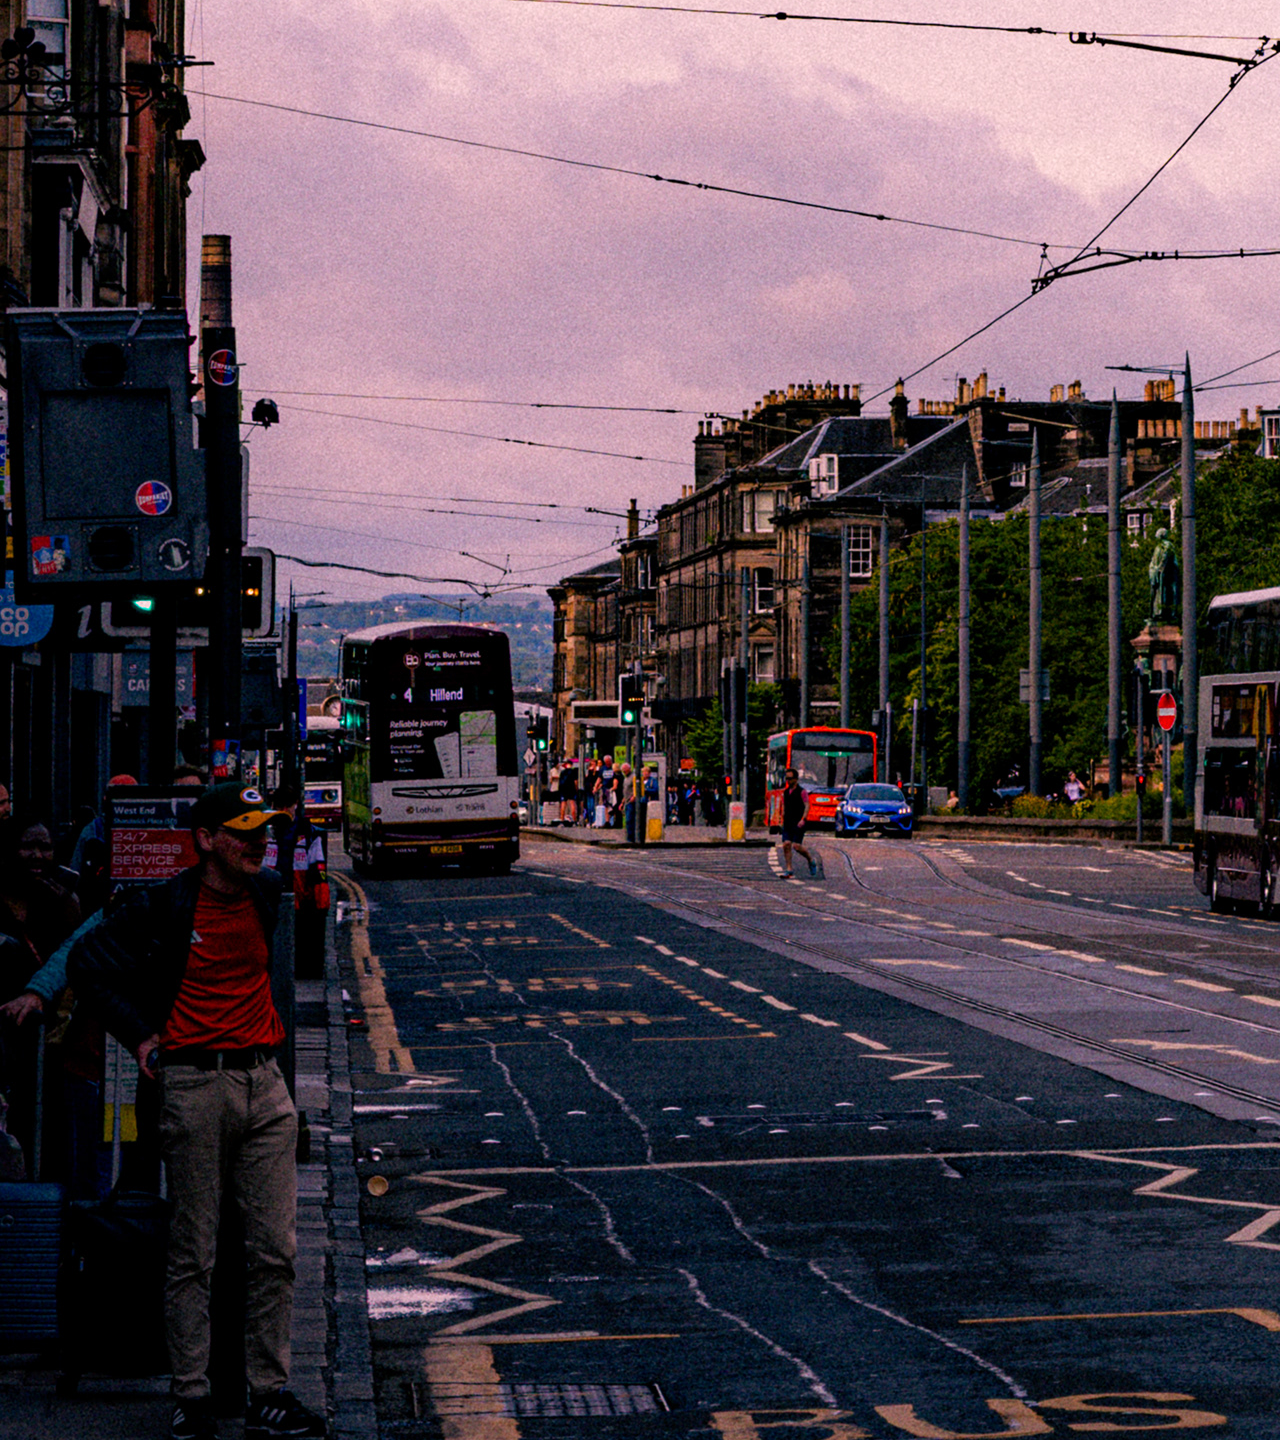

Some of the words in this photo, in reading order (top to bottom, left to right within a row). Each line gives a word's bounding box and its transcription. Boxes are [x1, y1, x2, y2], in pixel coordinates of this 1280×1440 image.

[459, 650, 481, 658] Travel.
[403, 687, 413, 703] 4
[430, 687, 463, 702] Hillend
[389, 720, 419, 728] Reliable
[420, 719, 448, 729] journey
[113, 805, 138, 815] West
[139, 805, 156, 815] End
[415, 806, 443, 814] Lothian
[112, 832, 148, 842] 24/7
[112, 843, 182, 854] EXPRESS
[112, 855, 175, 865] SERVICE
[128, 867, 144, 875] TO
